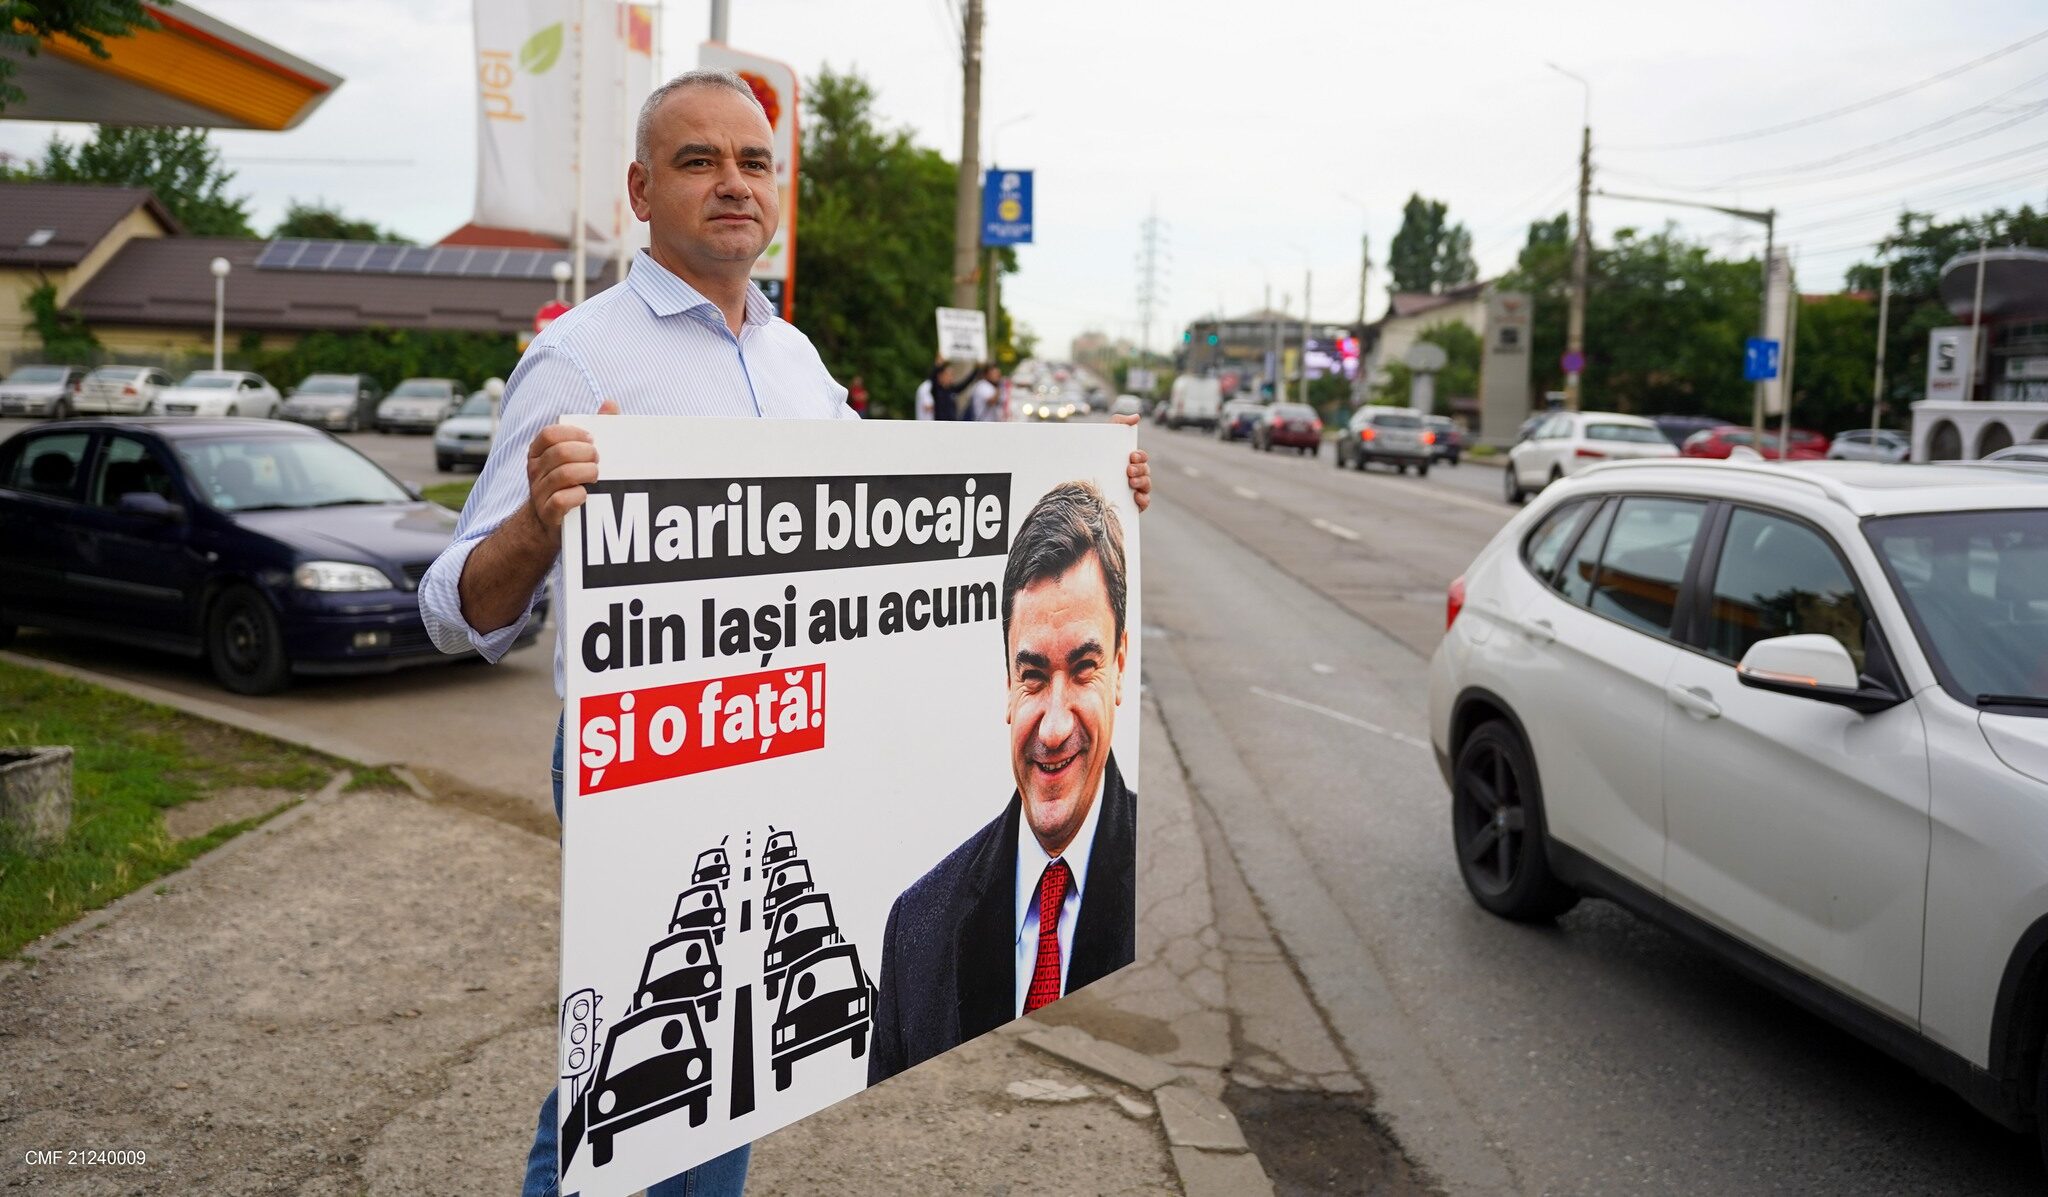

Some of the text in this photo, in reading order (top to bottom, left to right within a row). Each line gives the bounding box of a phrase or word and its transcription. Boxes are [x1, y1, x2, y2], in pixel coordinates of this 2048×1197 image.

[586, 478, 1002, 566] Marile blocaje
[582, 582, 997, 673] din Iași au acum
[581, 671, 823, 786] și o față!
